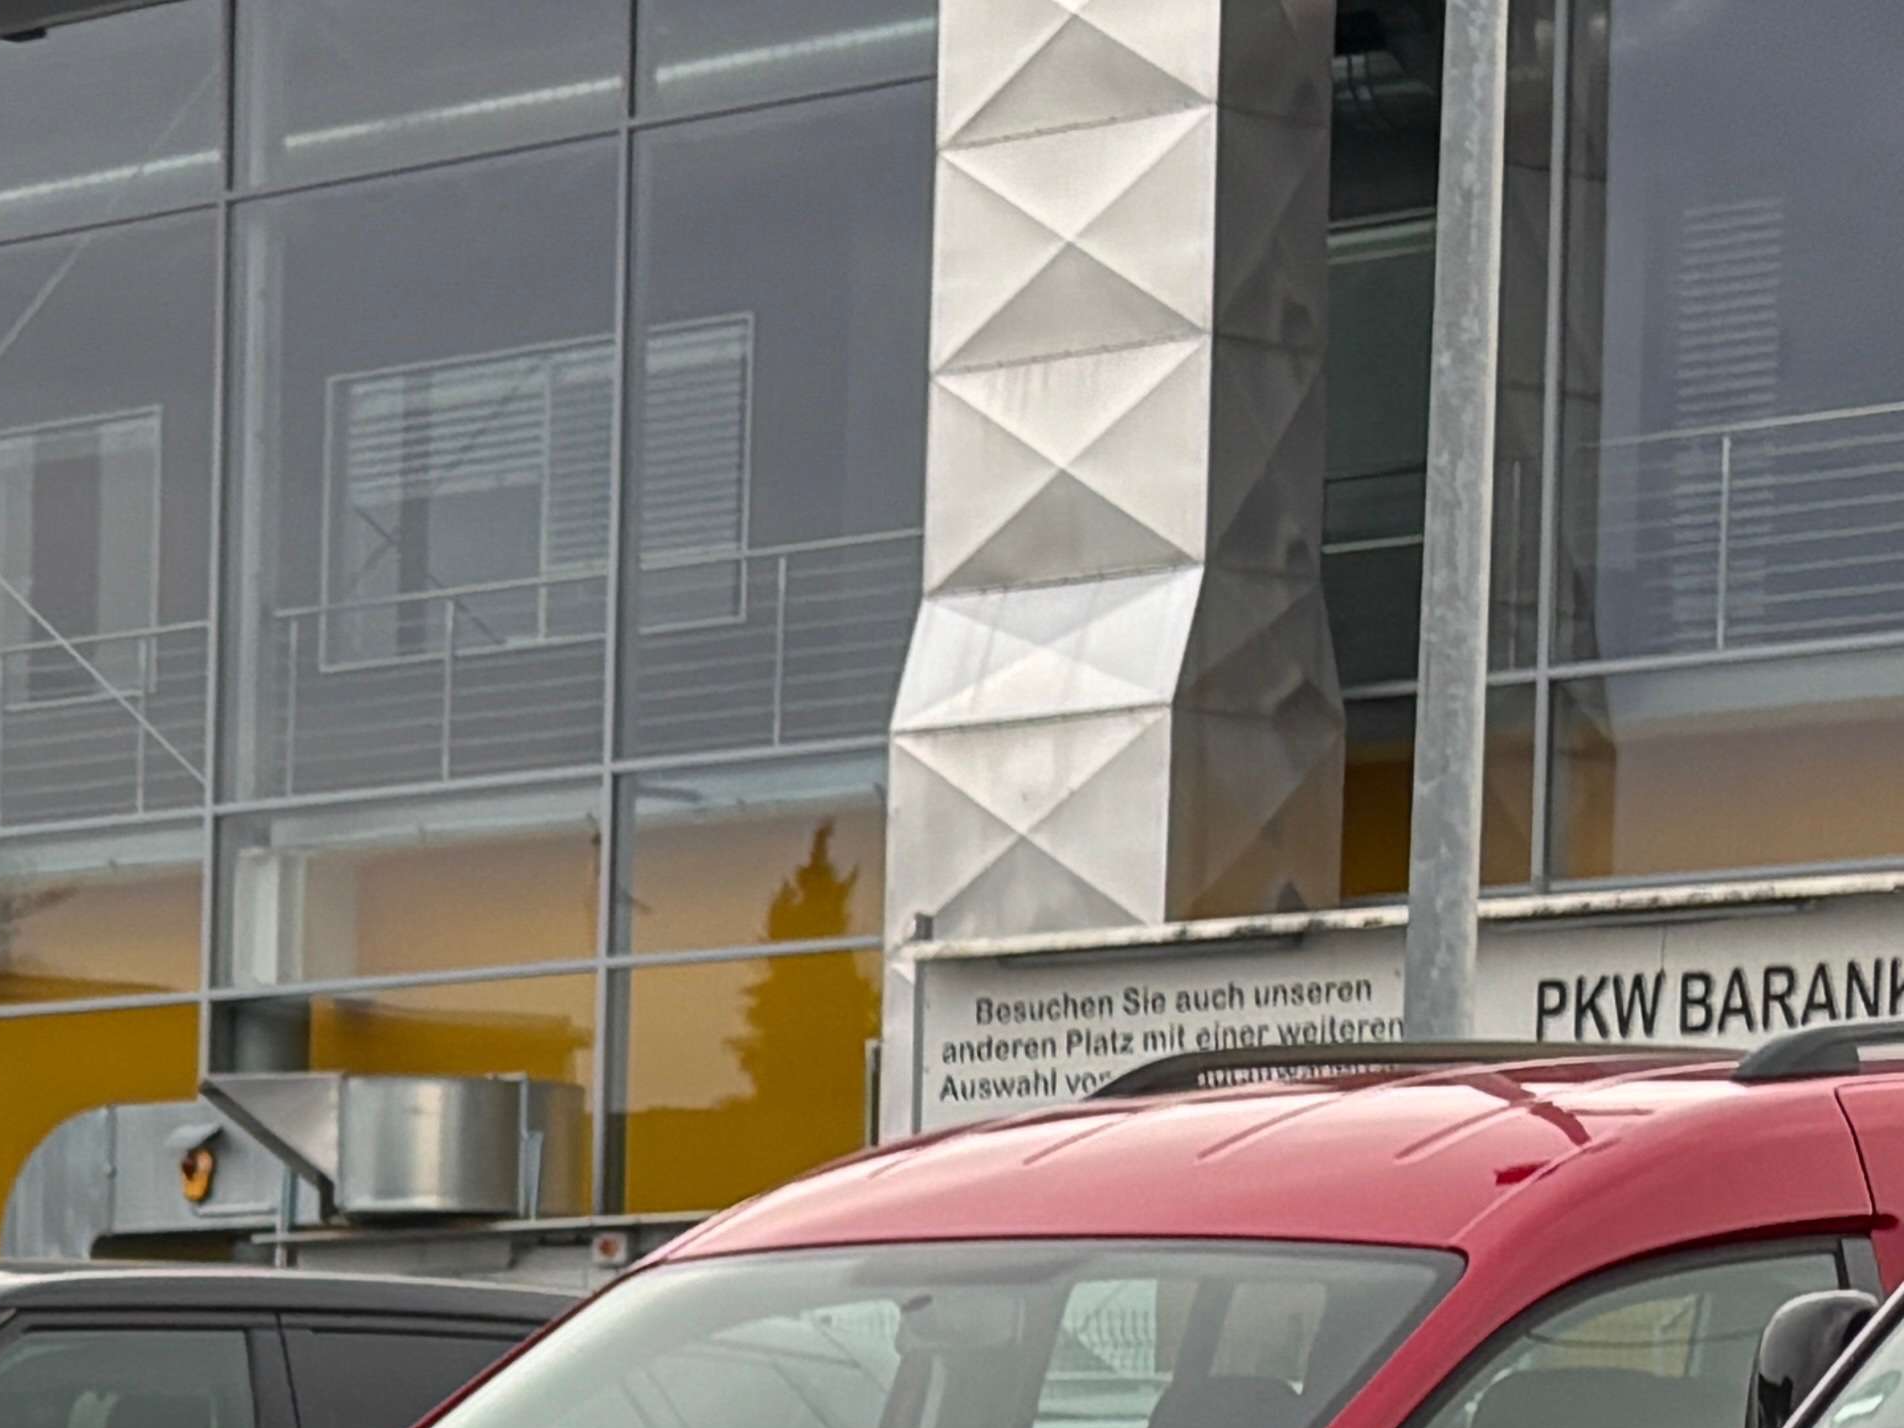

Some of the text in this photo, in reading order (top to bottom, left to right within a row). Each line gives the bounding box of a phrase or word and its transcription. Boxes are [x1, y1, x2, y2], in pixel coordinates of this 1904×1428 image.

[975, 977, 1372, 1025] Besuchen Sie auch unseren
[1536, 969, 1666, 1041] PKW
[941, 1014, 1404, 1065] anderen Platz mit einer weiteren
[939, 1066, 1057, 1101] Auswahl
